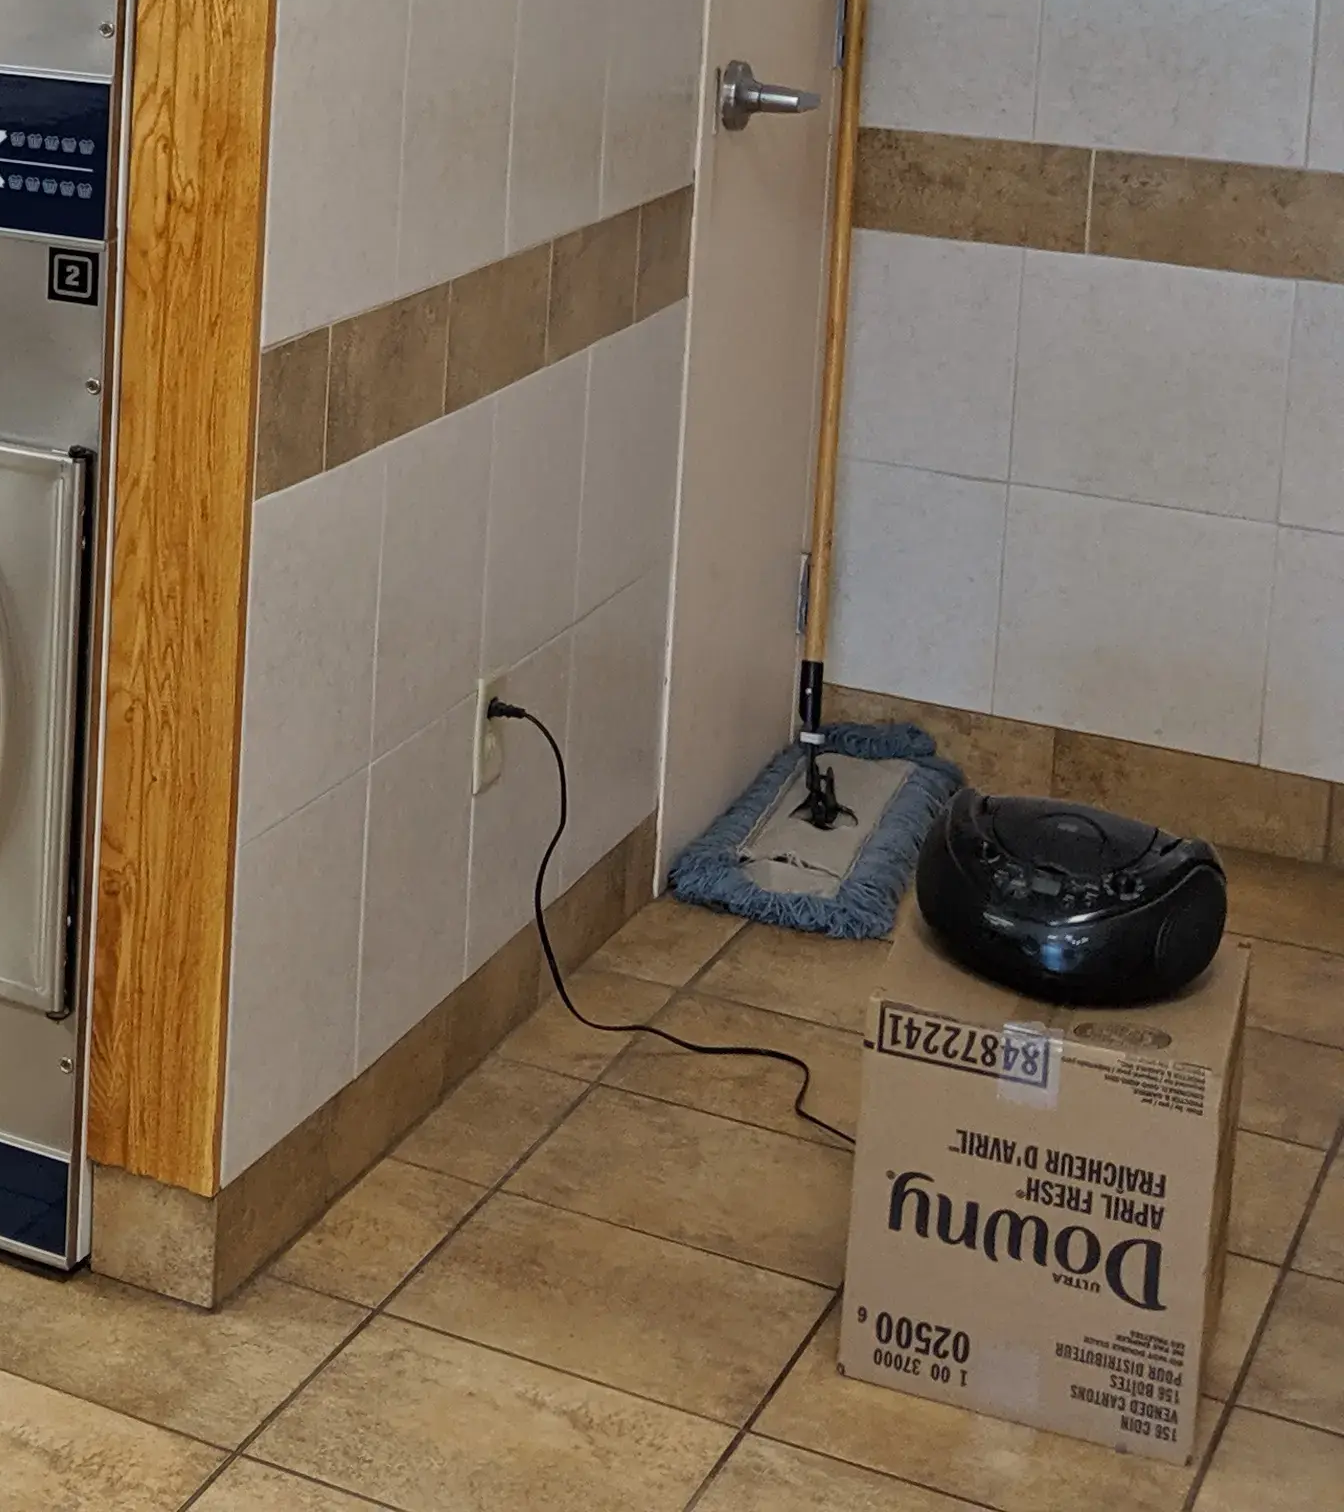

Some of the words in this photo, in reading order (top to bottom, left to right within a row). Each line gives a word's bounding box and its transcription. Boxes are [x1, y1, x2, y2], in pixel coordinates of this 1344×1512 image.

[65, 265, 79, 286] 2
[888, 1012, 1039, 1076] 84872241
[1045, 1148, 1167, 1198] FRAÎCHEUR
[1100, 1193, 1165, 1230] APRIL
[1052, 1273, 1101, 1293] ULTRA
[857, 1306, 868, 1323] 6
[875, 1311, 970, 1363] 02500
[873, 1348, 921, 1376] 37000
[1055, 1342, 1144, 1377] DISTRIBUTEUR
[931, 1363, 951, 1384] 00
[960, 1369, 968, 1387] 1
[1148, 1366, 1182, 1386] POUR
[1070, 1383, 1126, 1412] CARTONS
[1157, 1388, 1180, 1405] 156
[1129, 1399, 1178, 1425] VENDED
[1120, 1414, 1151, 1437] COIN
[1154, 1422, 1178, 1442] 156
